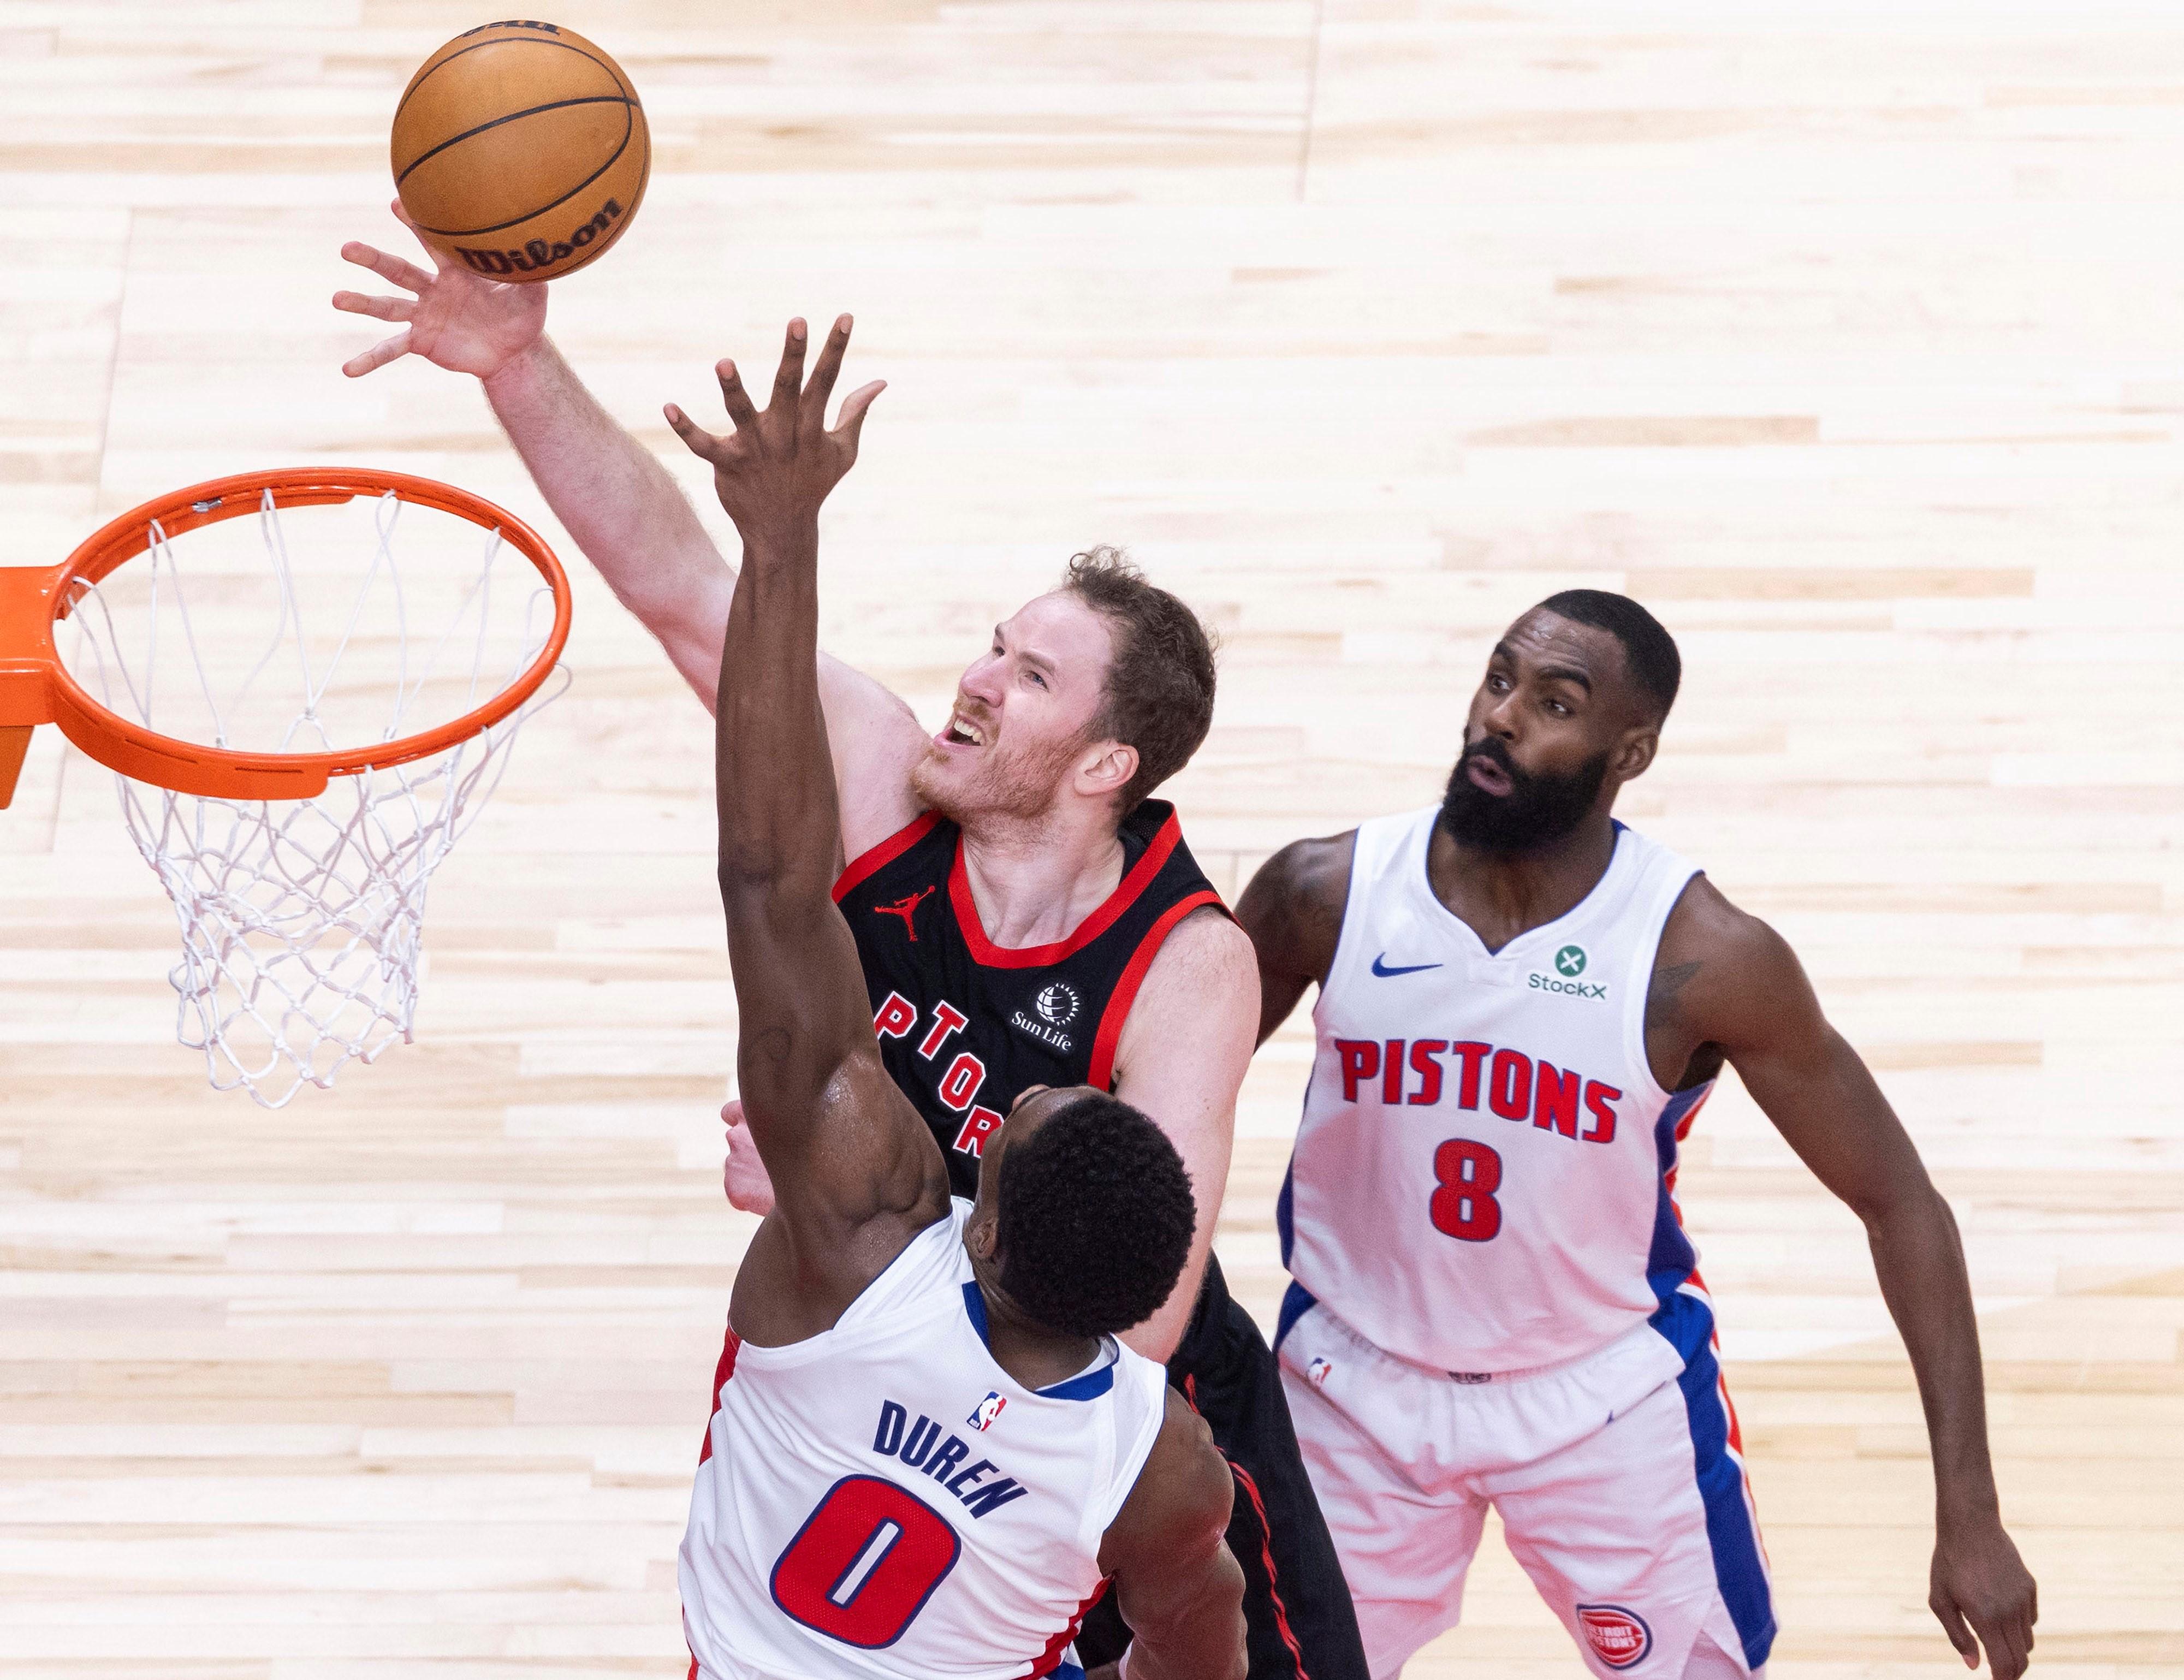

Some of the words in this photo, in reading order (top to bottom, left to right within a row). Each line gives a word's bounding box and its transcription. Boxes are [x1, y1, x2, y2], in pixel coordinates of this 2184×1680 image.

[454, 197, 623, 274] Wilson
[1012, 1011, 1042, 1036] Sun
[1042, 1026, 1072, 1051] Life
[1528, 973, 1607, 1000] StockX
[1334, 1038, 1623, 1144] PISTONS
[1429, 1138, 1503, 1243] 8
[873, 1399, 1029, 1520] DUREN
[769, 1474, 962, 1650] 0
